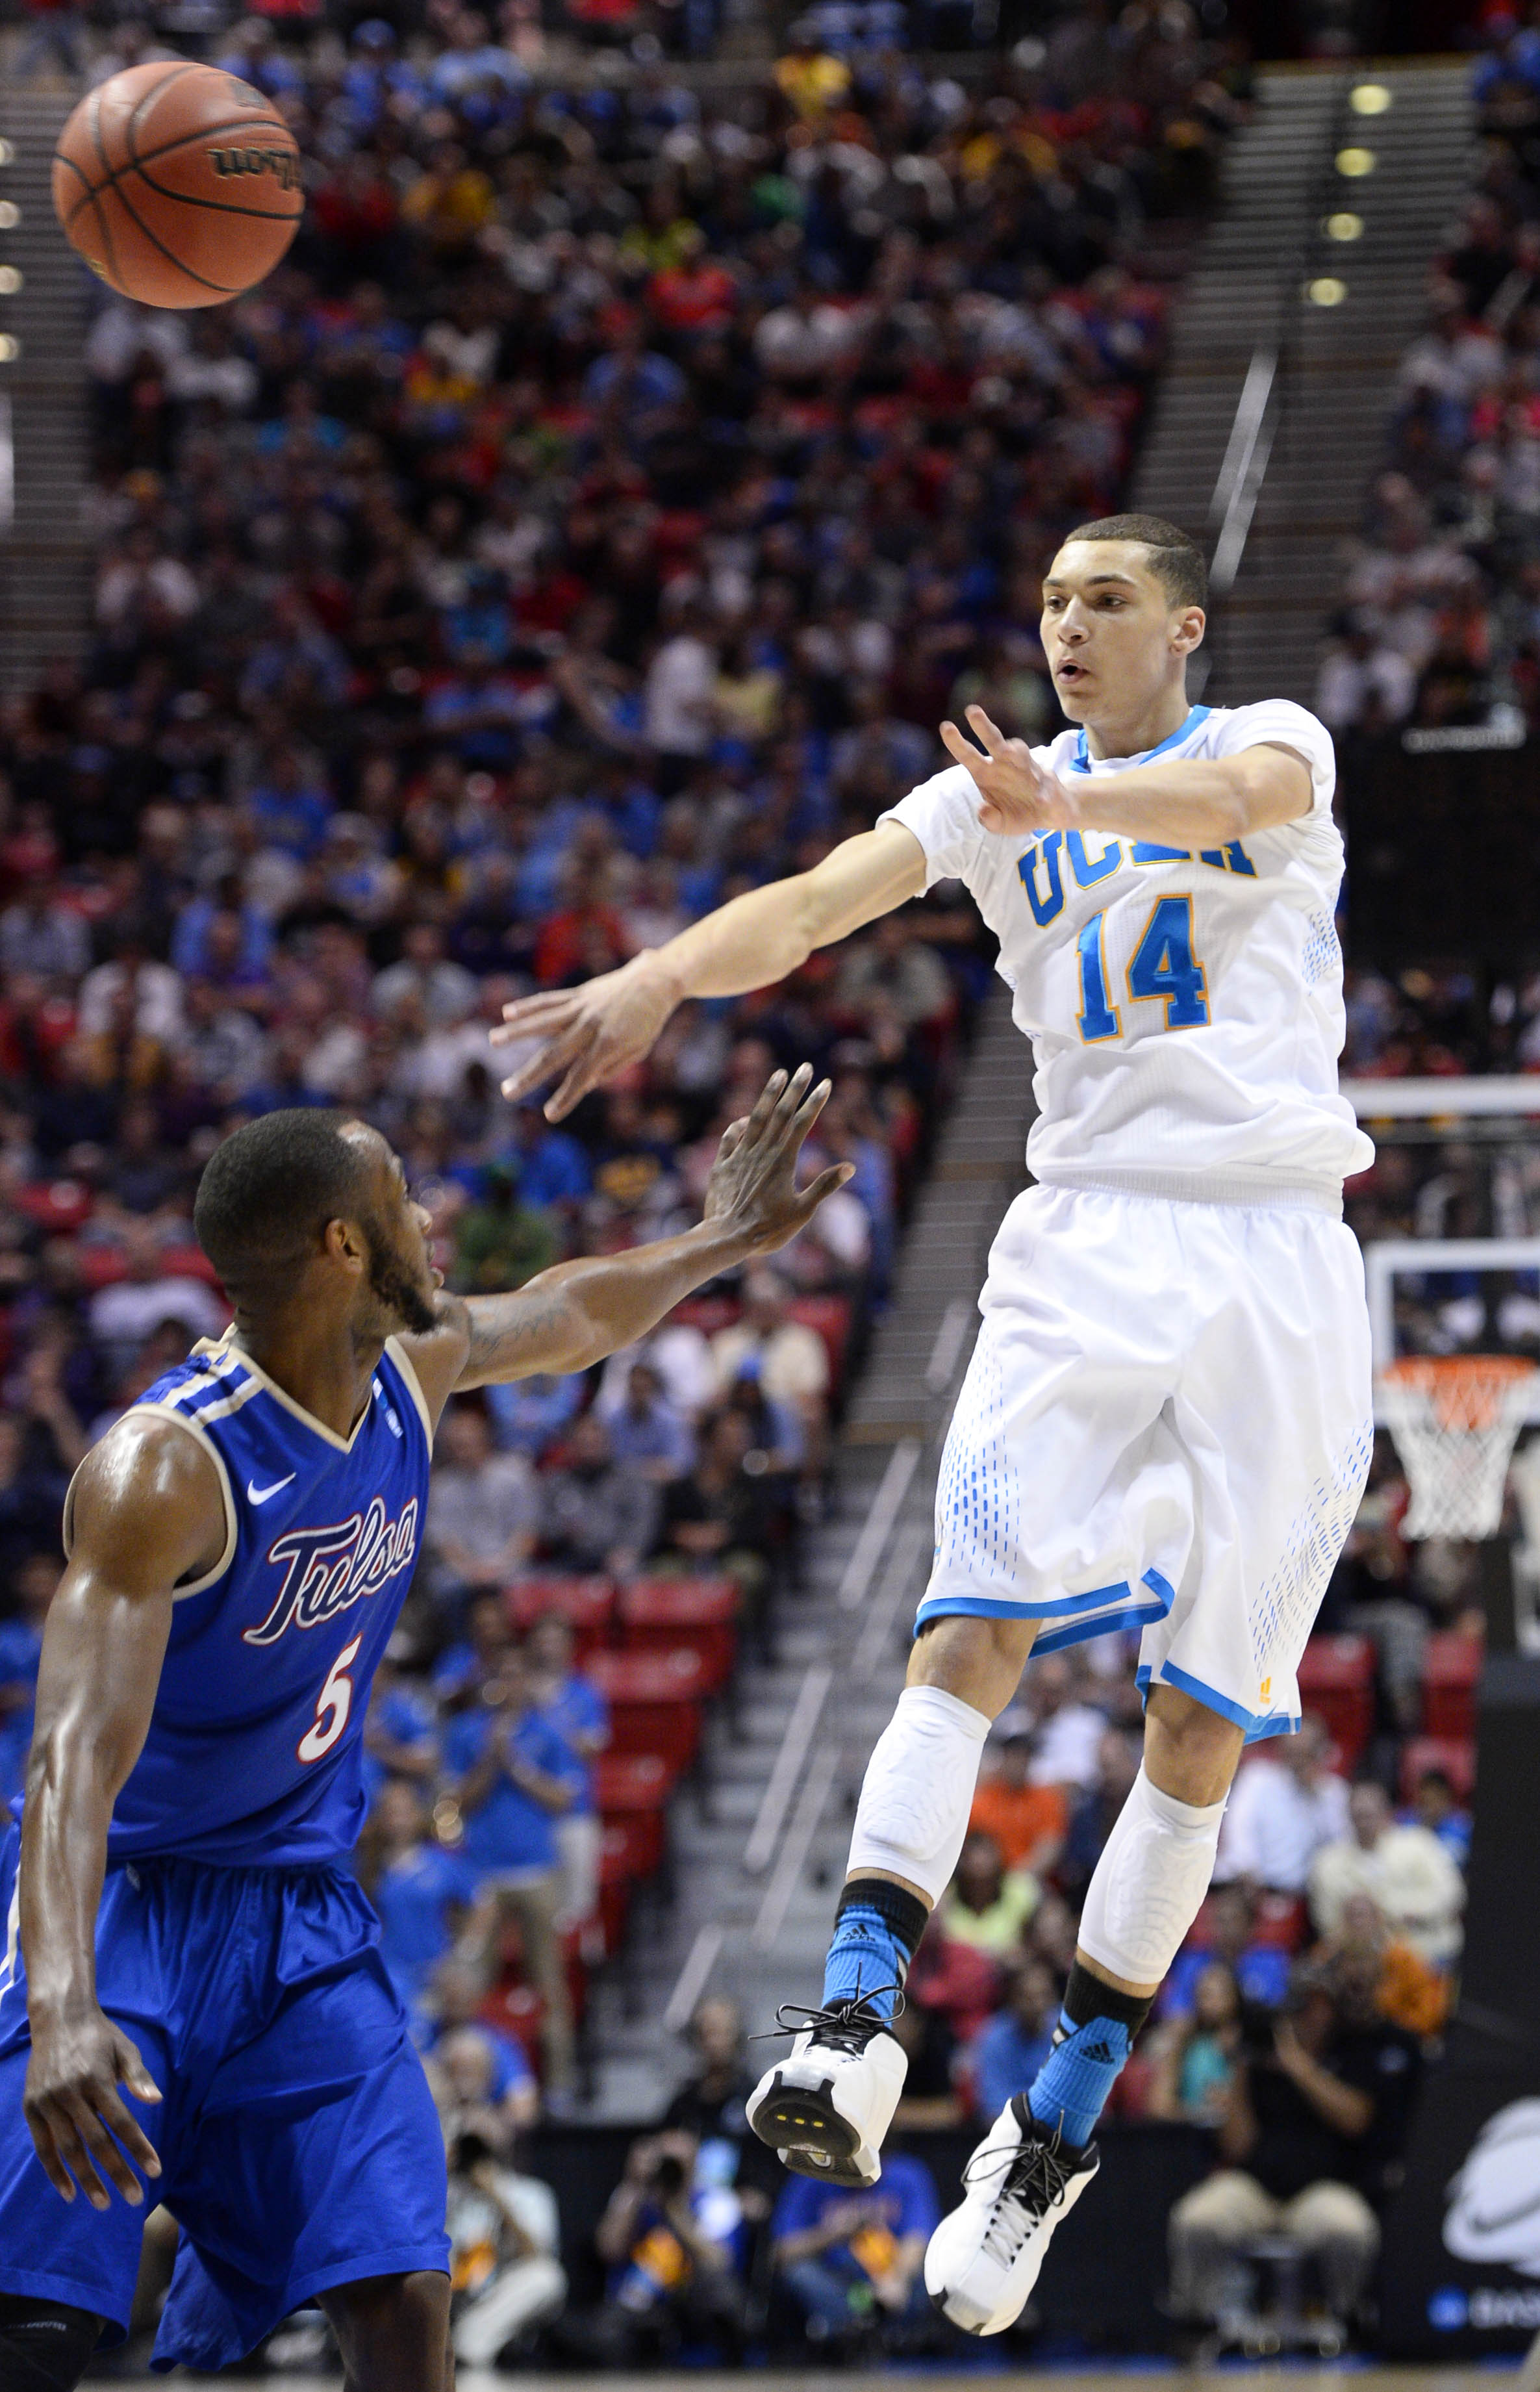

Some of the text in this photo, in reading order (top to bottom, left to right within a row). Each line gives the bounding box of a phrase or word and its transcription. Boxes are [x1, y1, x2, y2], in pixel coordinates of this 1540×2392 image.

[1075, 893, 1211, 1045] 14
[242, 1497, 418, 1645] Tulsa
[297, 1632, 363, 1764] 5
